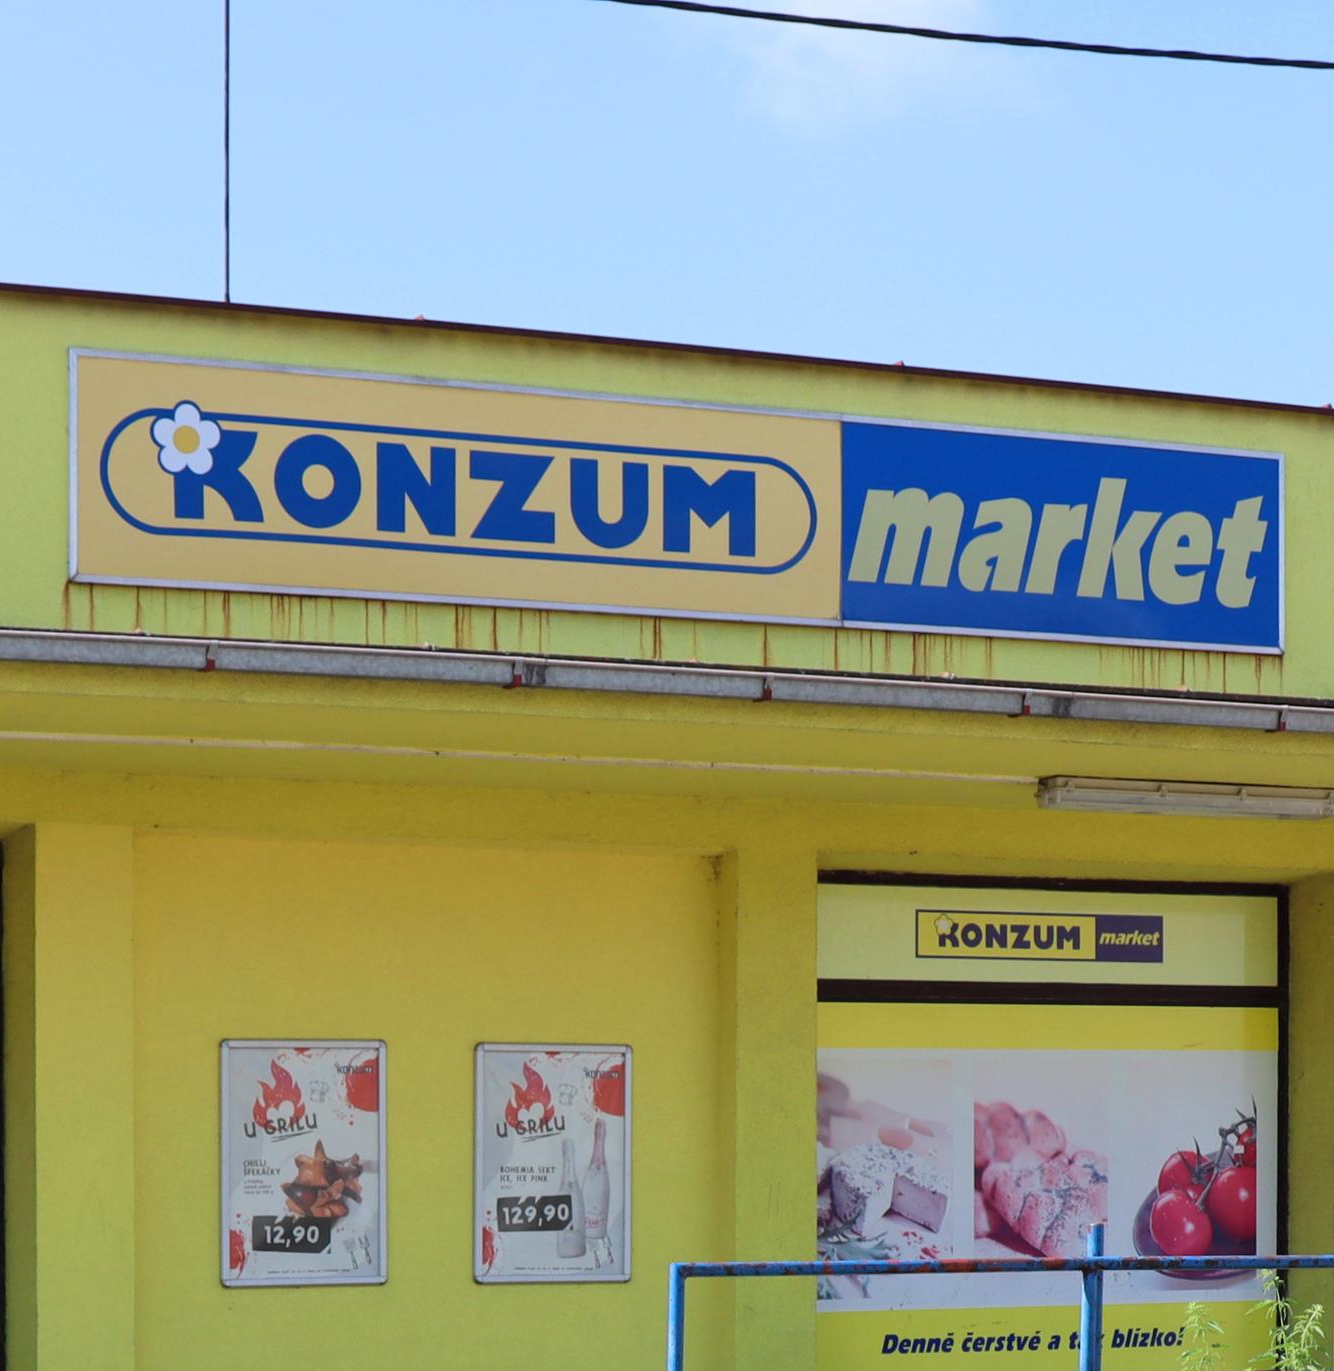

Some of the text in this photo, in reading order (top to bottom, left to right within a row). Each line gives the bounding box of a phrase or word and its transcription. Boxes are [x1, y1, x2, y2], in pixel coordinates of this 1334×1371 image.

[173, 429, 1268, 609] KONZUM market
[938, 922, 1160, 951] KONZUM market
[243, 1112, 318, 1139] U GRILU
[495, 1115, 566, 1138] U GRILU
[499, 1166, 534, 1174] BOHEMIA
[502, 1203, 570, 1227] 129,90
[263, 1225, 320, 1248] 12,90
[881, 1332, 955, 1355] Denně
[965, 1331, 1041, 1353] čerstvé
[1047, 1335, 1061, 1350] a
[1111, 1326, 1186, 1349] blízko!
